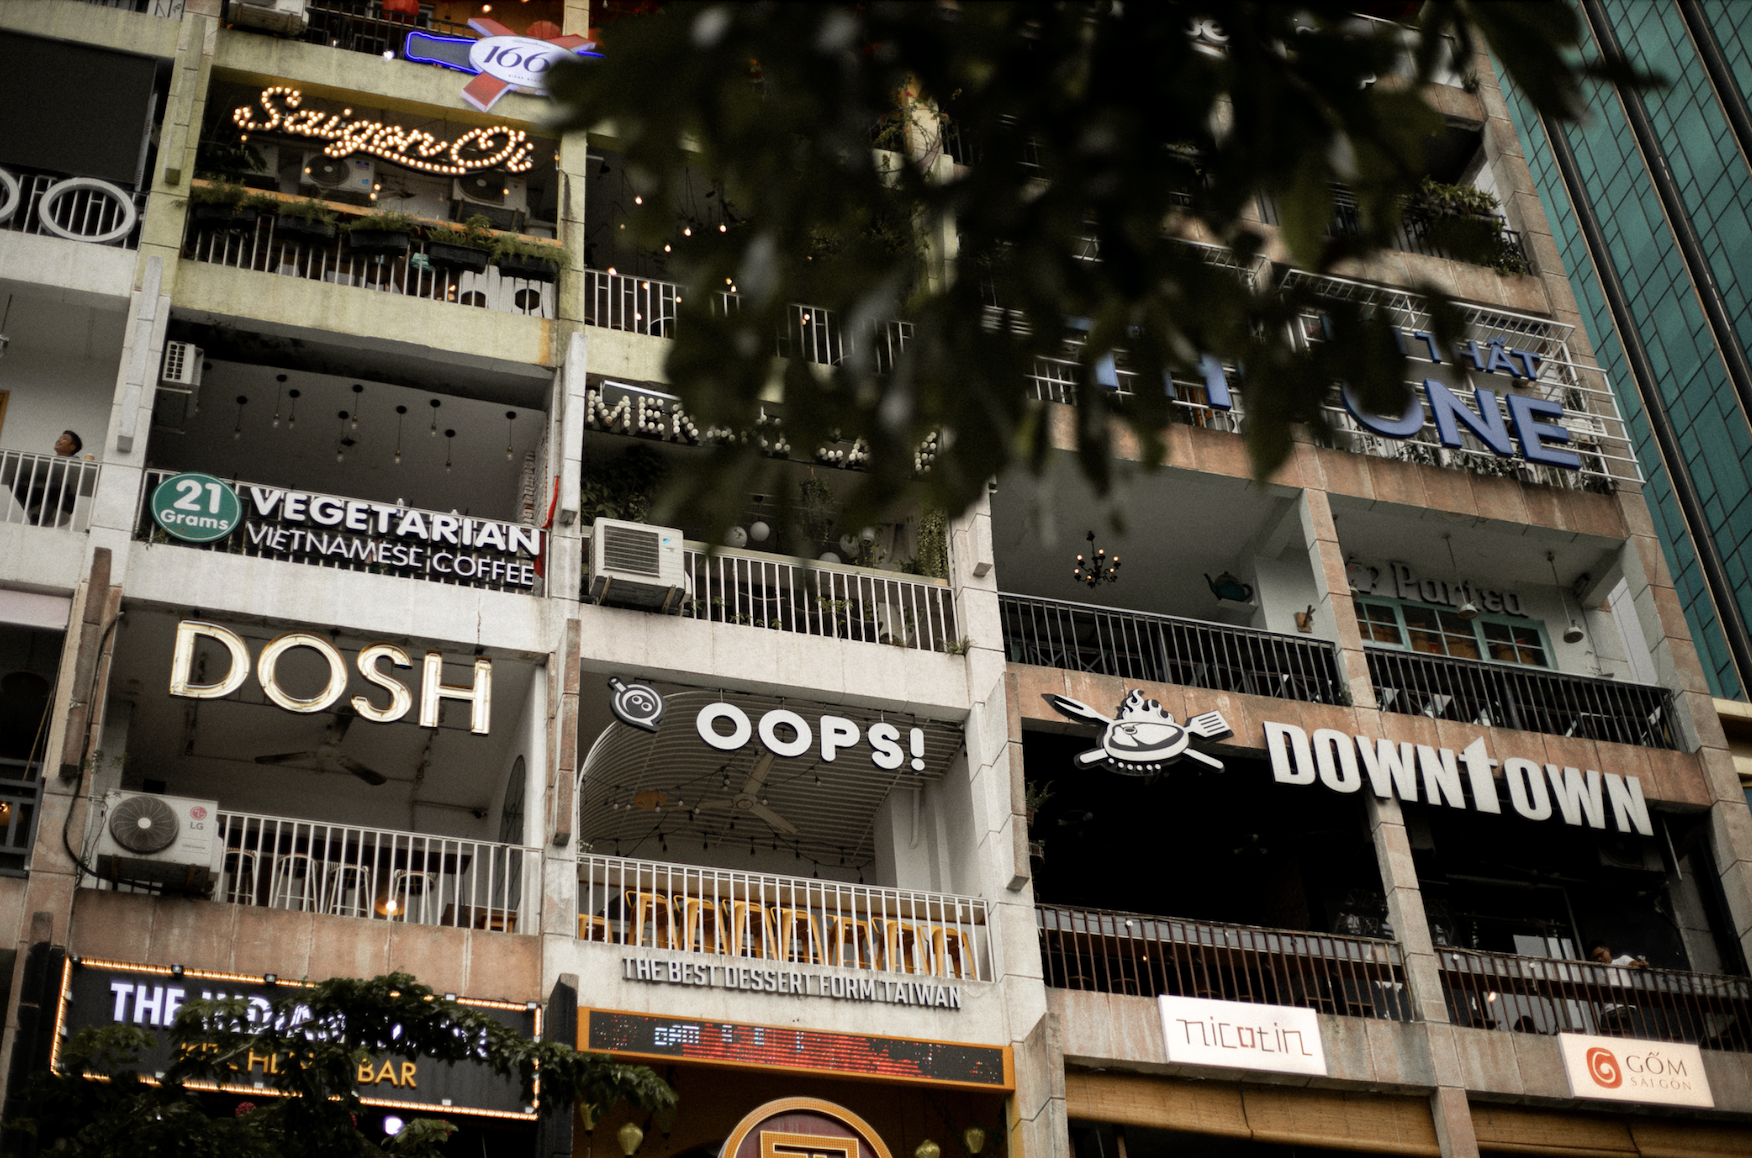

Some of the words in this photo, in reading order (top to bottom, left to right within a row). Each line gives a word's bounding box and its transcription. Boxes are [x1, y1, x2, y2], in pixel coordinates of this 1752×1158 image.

[483, 45, 551, 73] 166
[233, 85, 454, 166] Saigon
[173, 479, 222, 514] 21
[160, 508, 229, 531] Grams
[250, 486, 540, 556] VEGETARIAN
[247, 522, 423, 568] VIETNAMESE
[432, 552, 535, 586] COFFEE
[169, 618, 492, 735] DOSH
[696, 702, 925, 771] OOPS!
[190, 822, 204, 830] LG
[110, 981, 185, 1027] THE
[622, 957, 663, 982] THE
[667, 959, 717, 986] BEST
[724, 965, 812, 995] DESSERT
[819, 974, 877, 1001] FORM
[882, 981, 961, 1010] TAIWAN
[1176, 1016, 1313, 1056] nicotin
[357, 1057, 417, 1089] BAR
[1625, 1052, 1688, 1077] GỐM
